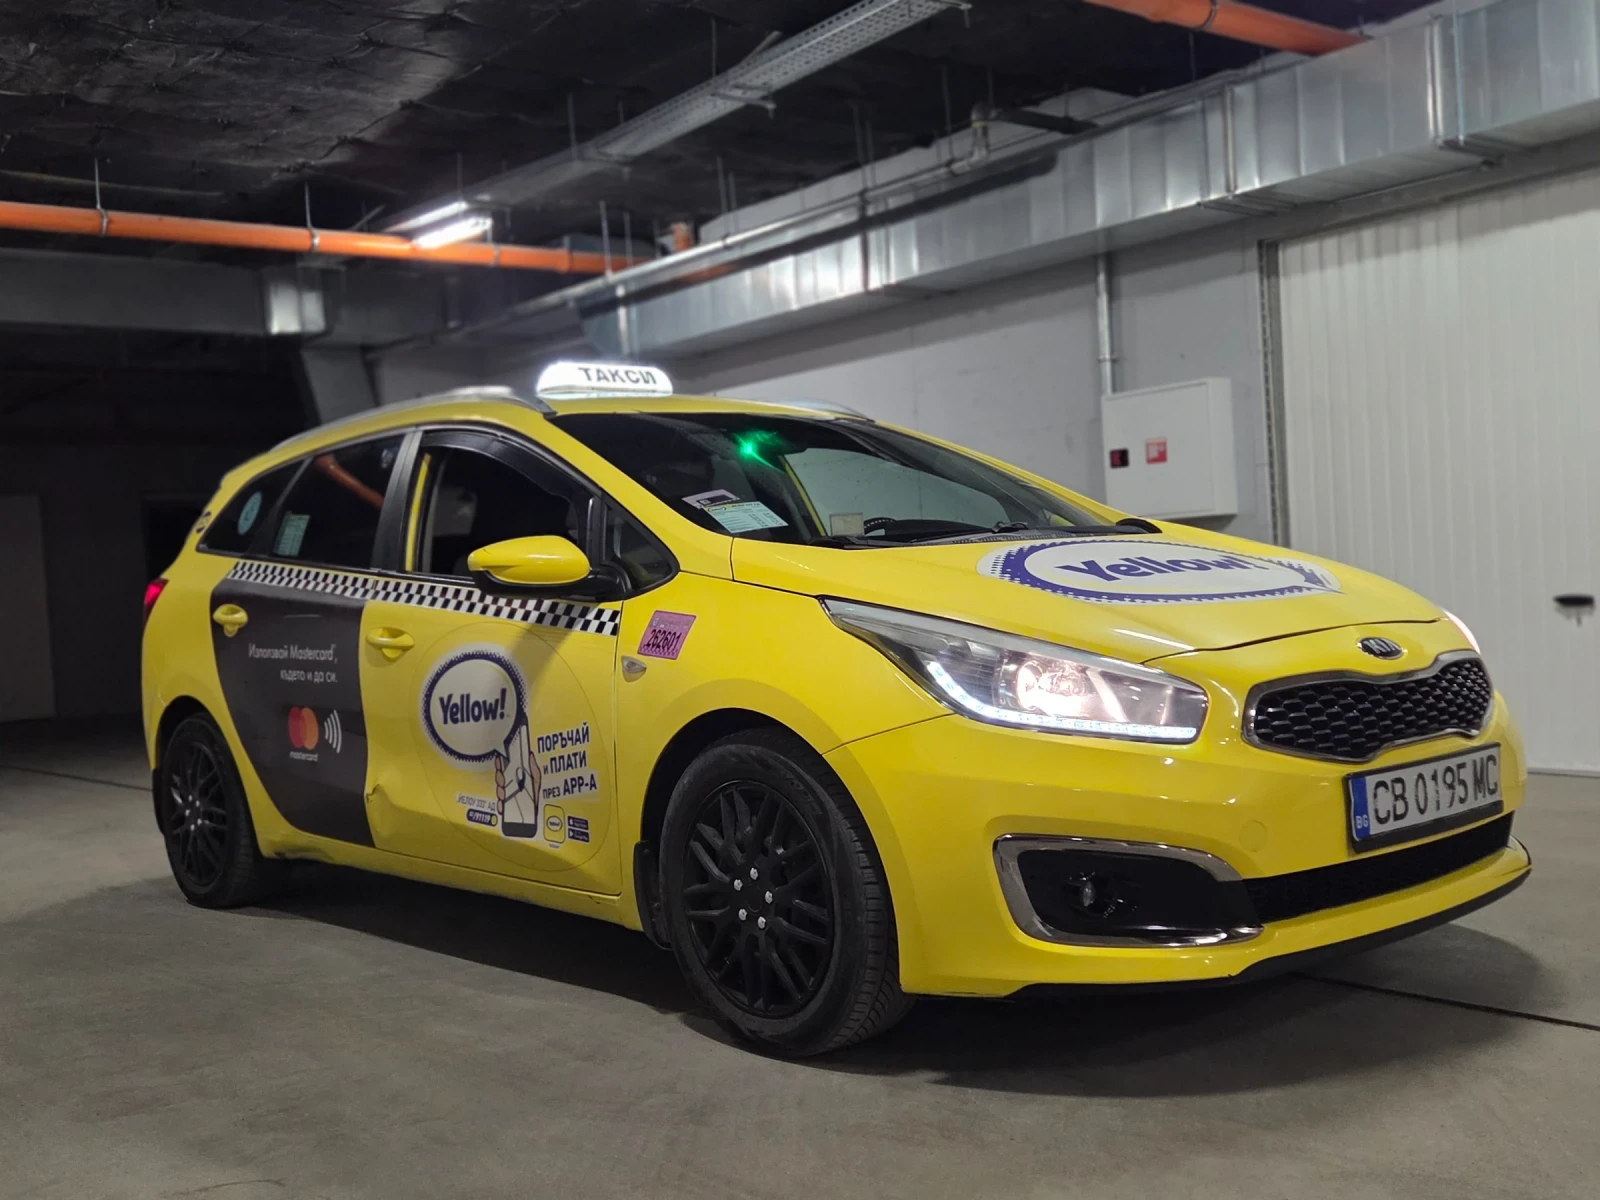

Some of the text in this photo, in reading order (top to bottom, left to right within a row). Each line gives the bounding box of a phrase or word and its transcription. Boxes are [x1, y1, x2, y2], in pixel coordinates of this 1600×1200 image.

[578, 367, 657, 385] ТАКСИ
[1054, 555, 1269, 582] Yellow!
[646, 629, 682, 651] 262601
[307, 671, 313, 681] и
[439, 688, 507, 724] Yellow!
[537, 722, 590, 753] ПОРЪЧАЙ
[543, 751, 587, 775] и ПЛАТИ
[543, 786, 561, 799] ПРЕЗ
[1373, 754, 1498, 825] CB 0195 MC
[1356, 814, 1369, 829] BG
